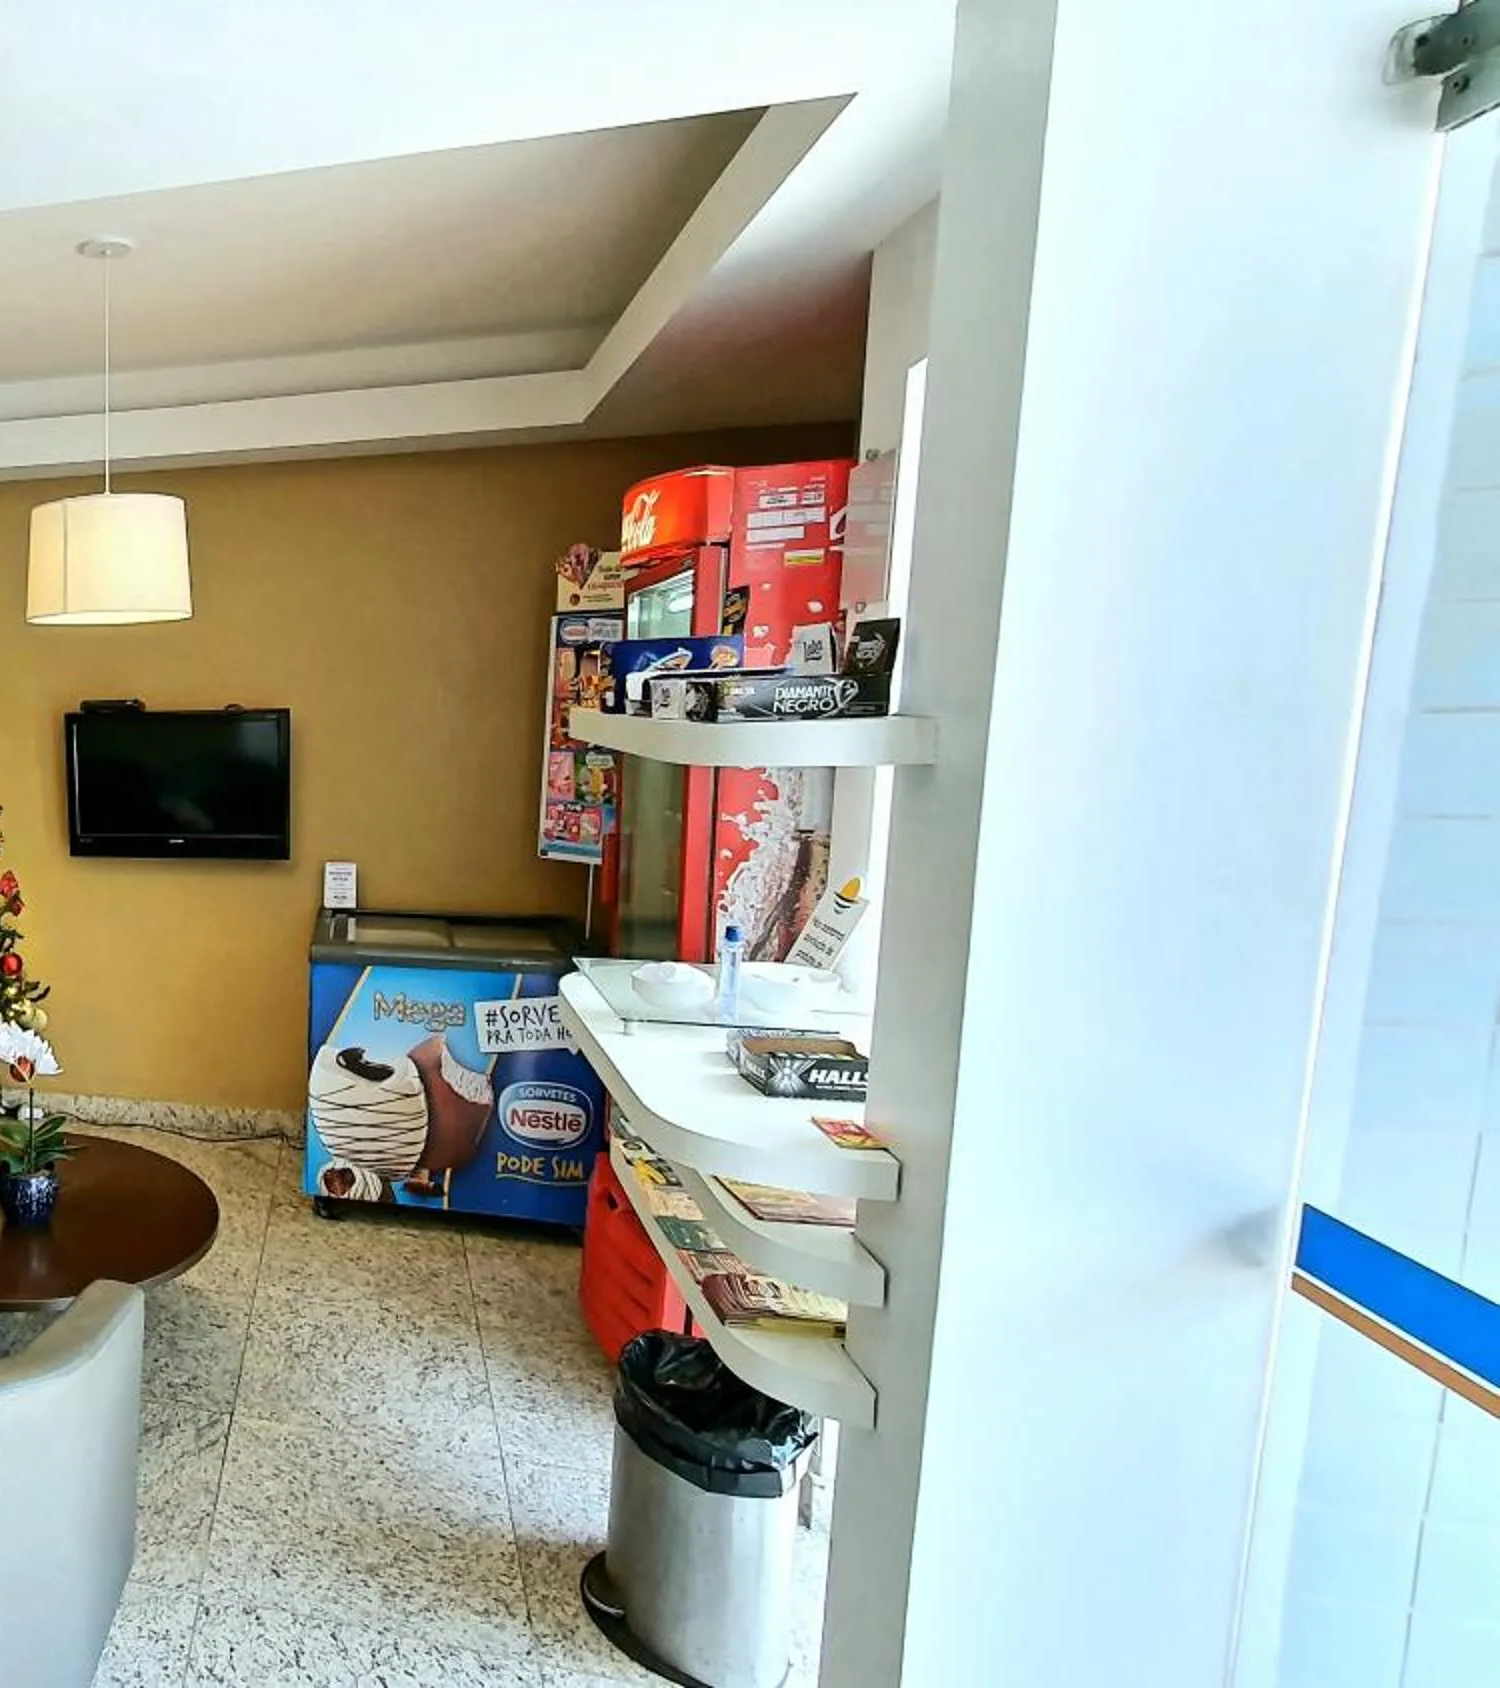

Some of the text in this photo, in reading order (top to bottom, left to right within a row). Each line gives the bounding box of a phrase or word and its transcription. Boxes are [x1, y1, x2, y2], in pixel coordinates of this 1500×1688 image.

[773, 699, 835, 714] NEGRO
[374, 991, 465, 1032] Mega
[486, 1029, 515, 1045] PRA
[517, 1027, 553, 1043] TODA
[518, 1087, 577, 1103] SORVETES
[510, 1108, 582, 1133] Nestlé
[496, 1151, 584, 1180] PODE SIM
